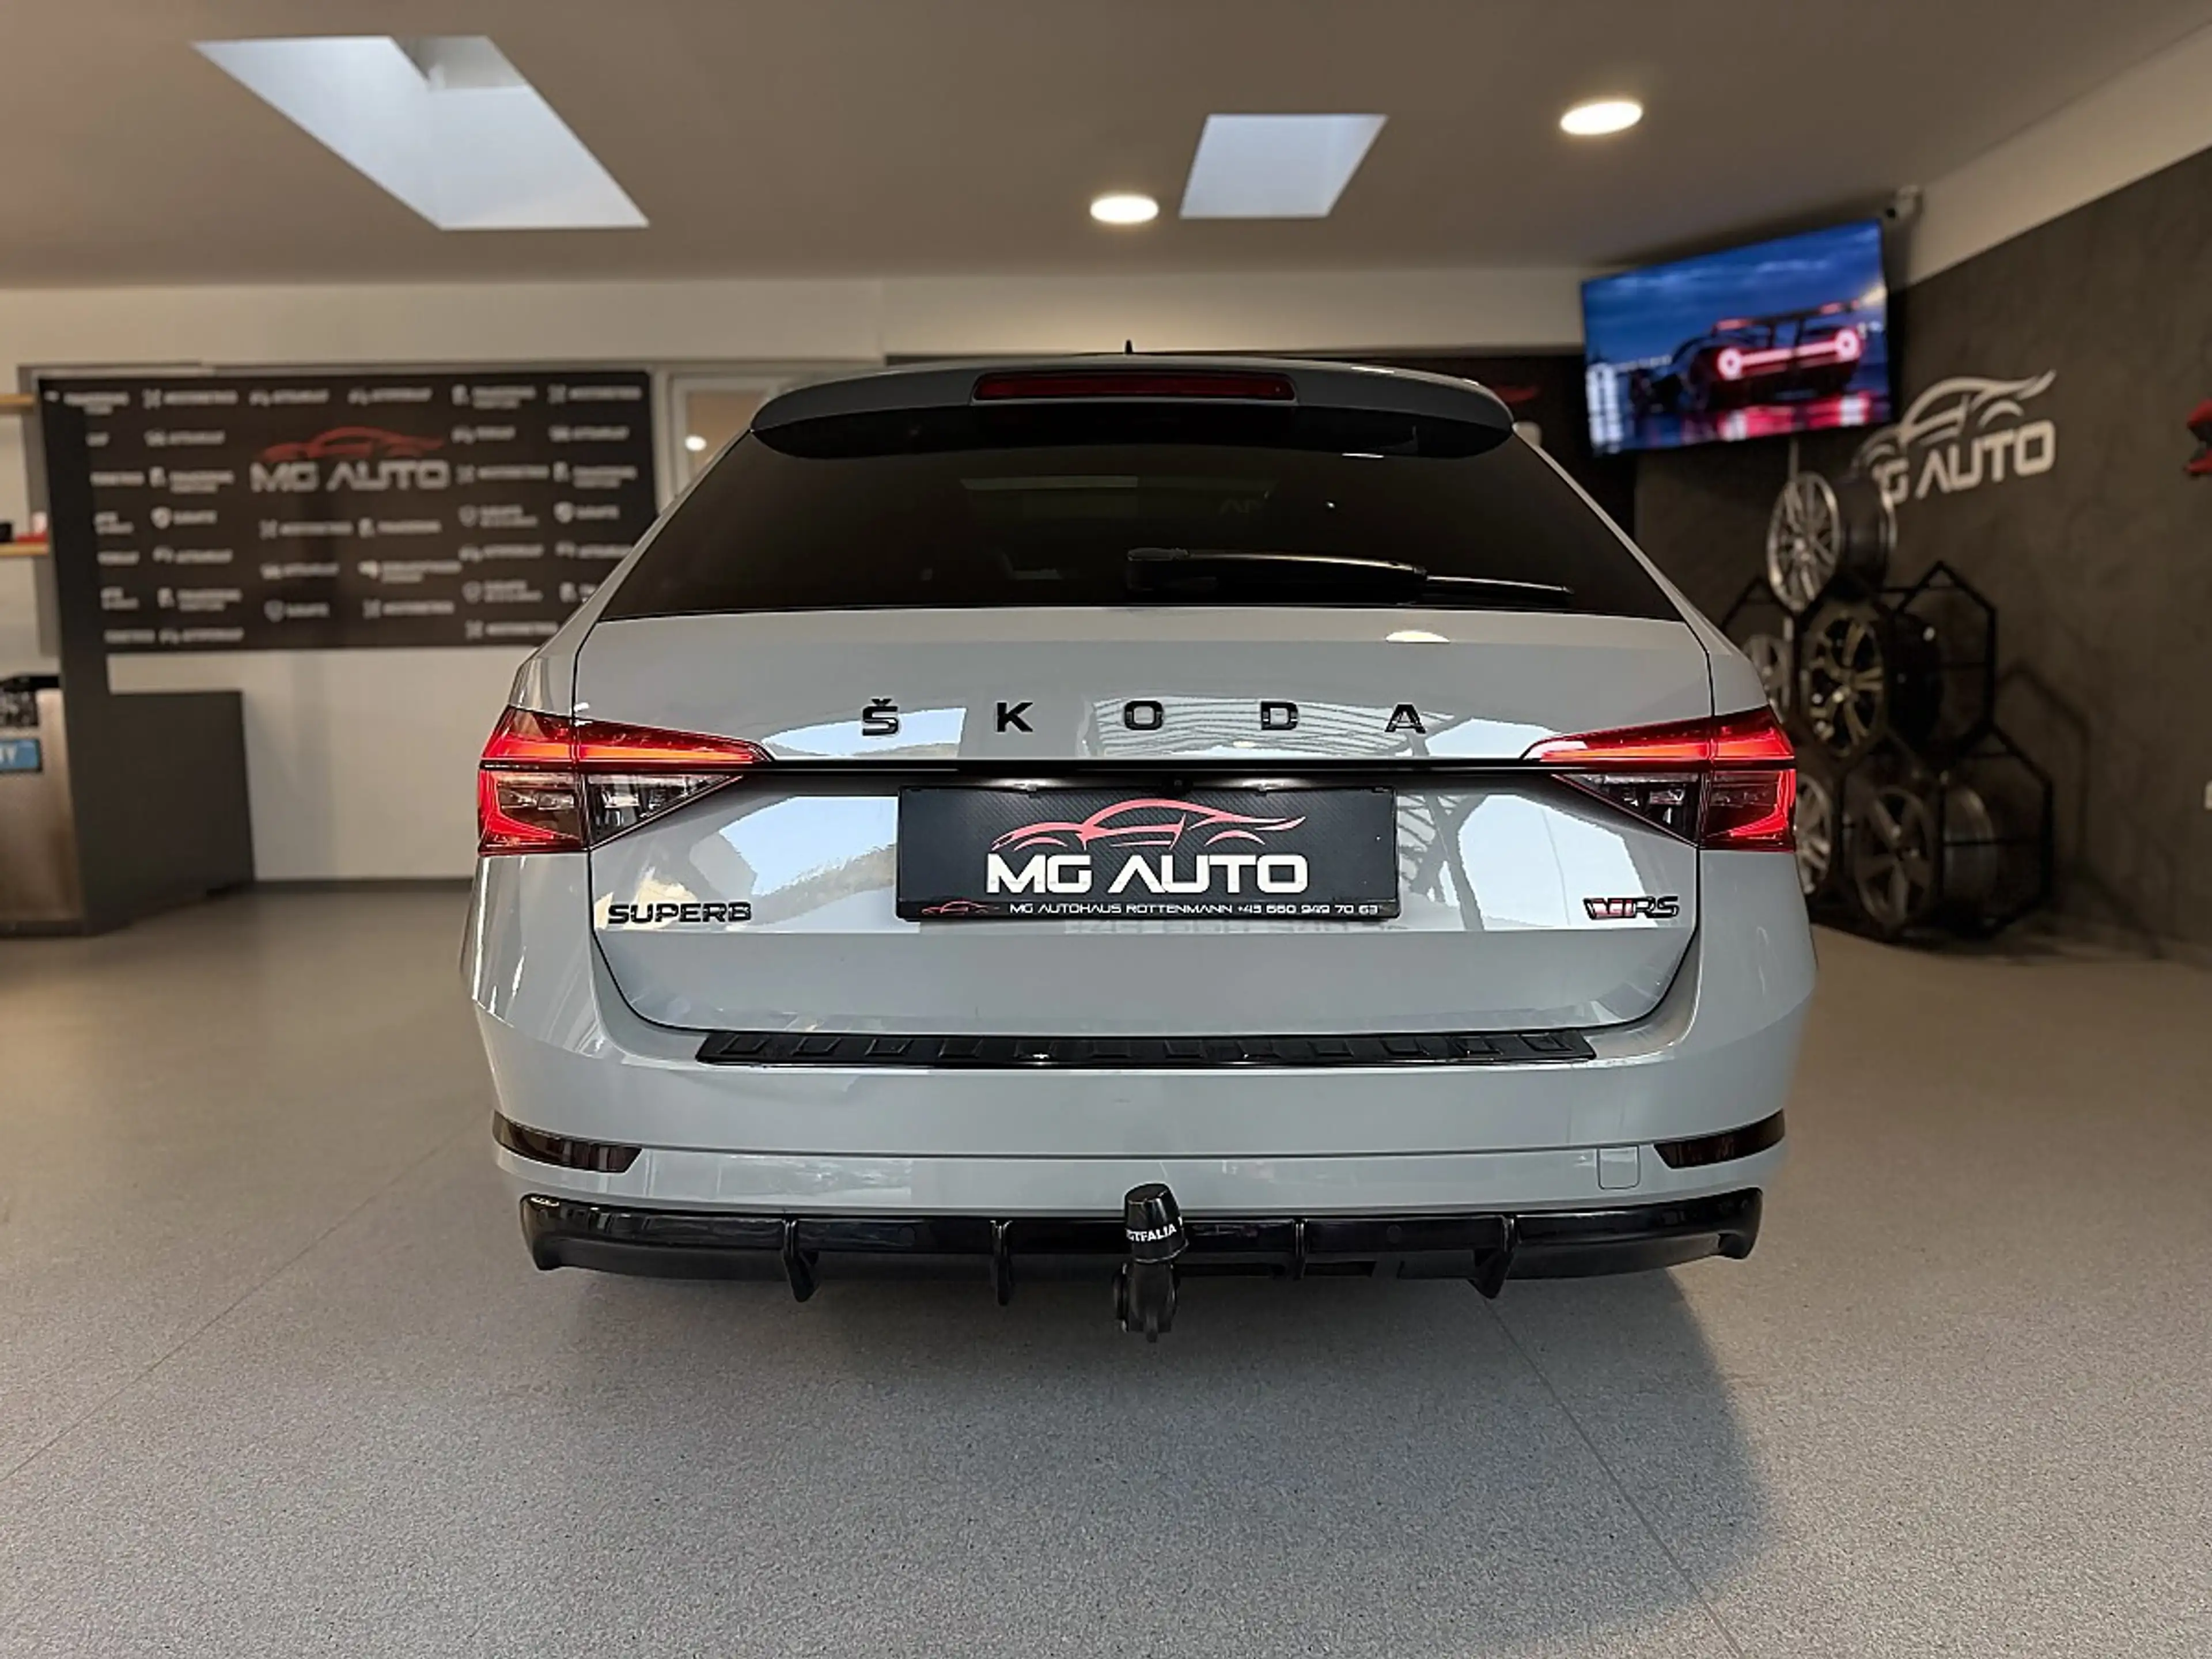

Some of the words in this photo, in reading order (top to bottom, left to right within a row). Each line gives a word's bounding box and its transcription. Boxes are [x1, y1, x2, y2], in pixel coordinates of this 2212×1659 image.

[1915, 420, 2056, 499] AUTO
[250, 461, 319, 493] MG
[326, 460, 450, 492] AUTO
[987, 854, 1092, 894] MG
[1107, 854, 1309, 894] AUTO
[608, 901, 751, 924] SUPERB
[1010, 904, 1033, 914] MG
[1037, 903, 1122, 914] AUTOHAUS
[1126, 903, 1233, 914] ROTTENMANN
[1334, 904, 1354, 914] 70
[1358, 904, 1378, 915] 63
